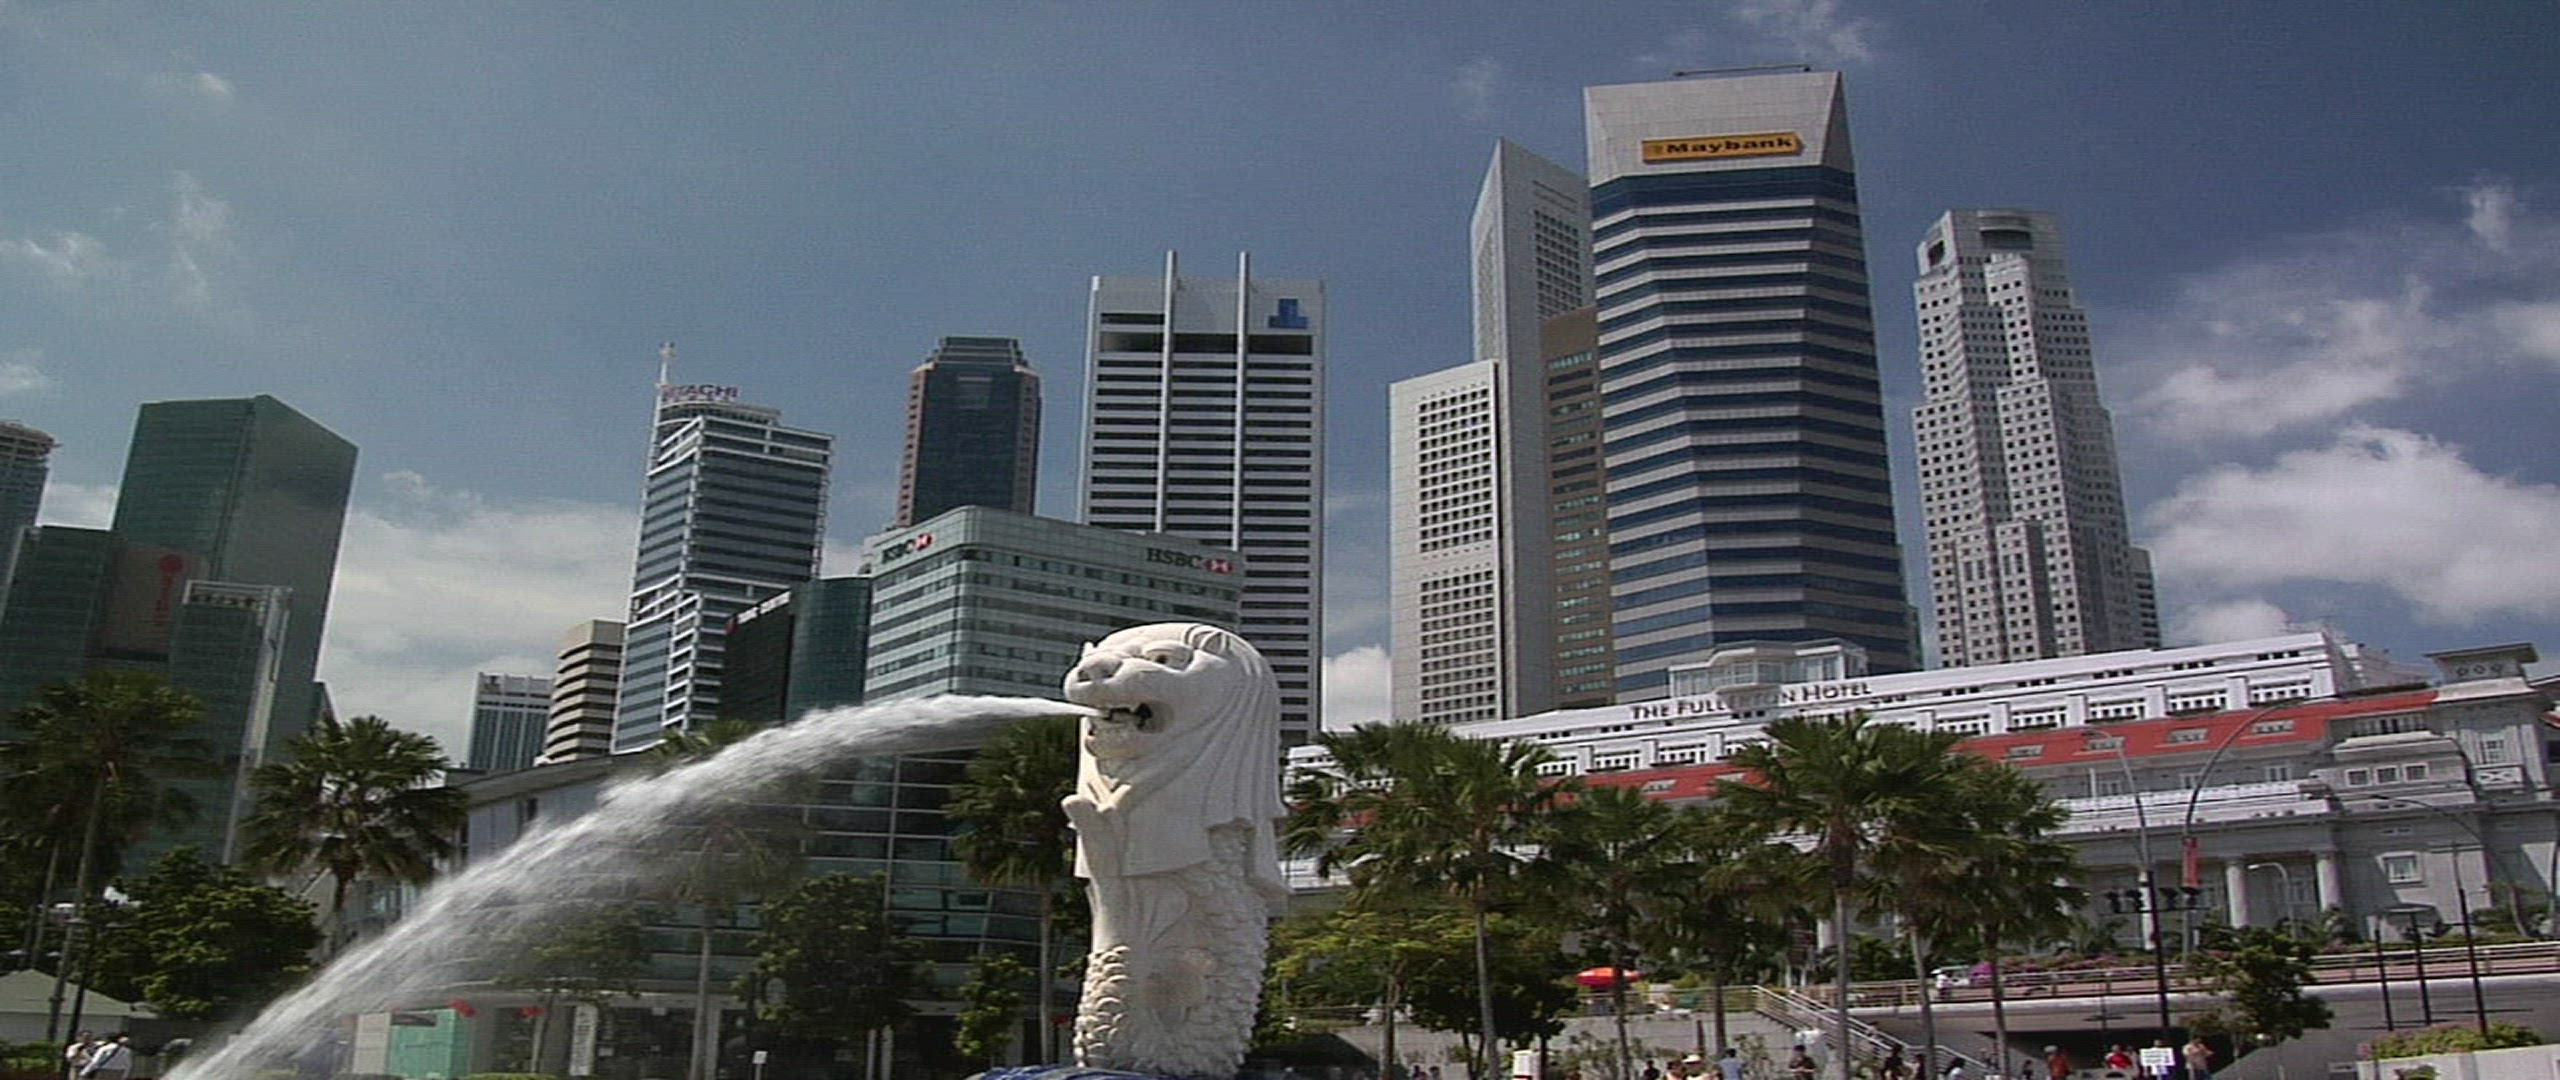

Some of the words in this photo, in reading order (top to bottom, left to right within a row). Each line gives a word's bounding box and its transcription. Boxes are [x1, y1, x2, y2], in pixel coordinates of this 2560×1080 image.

[1666, 138, 1793, 154] Maybank
[1147, 547, 1203, 569] HSBC
[1631, 705, 1669, 720] THE
[1802, 682, 1872, 702] HOTEL
